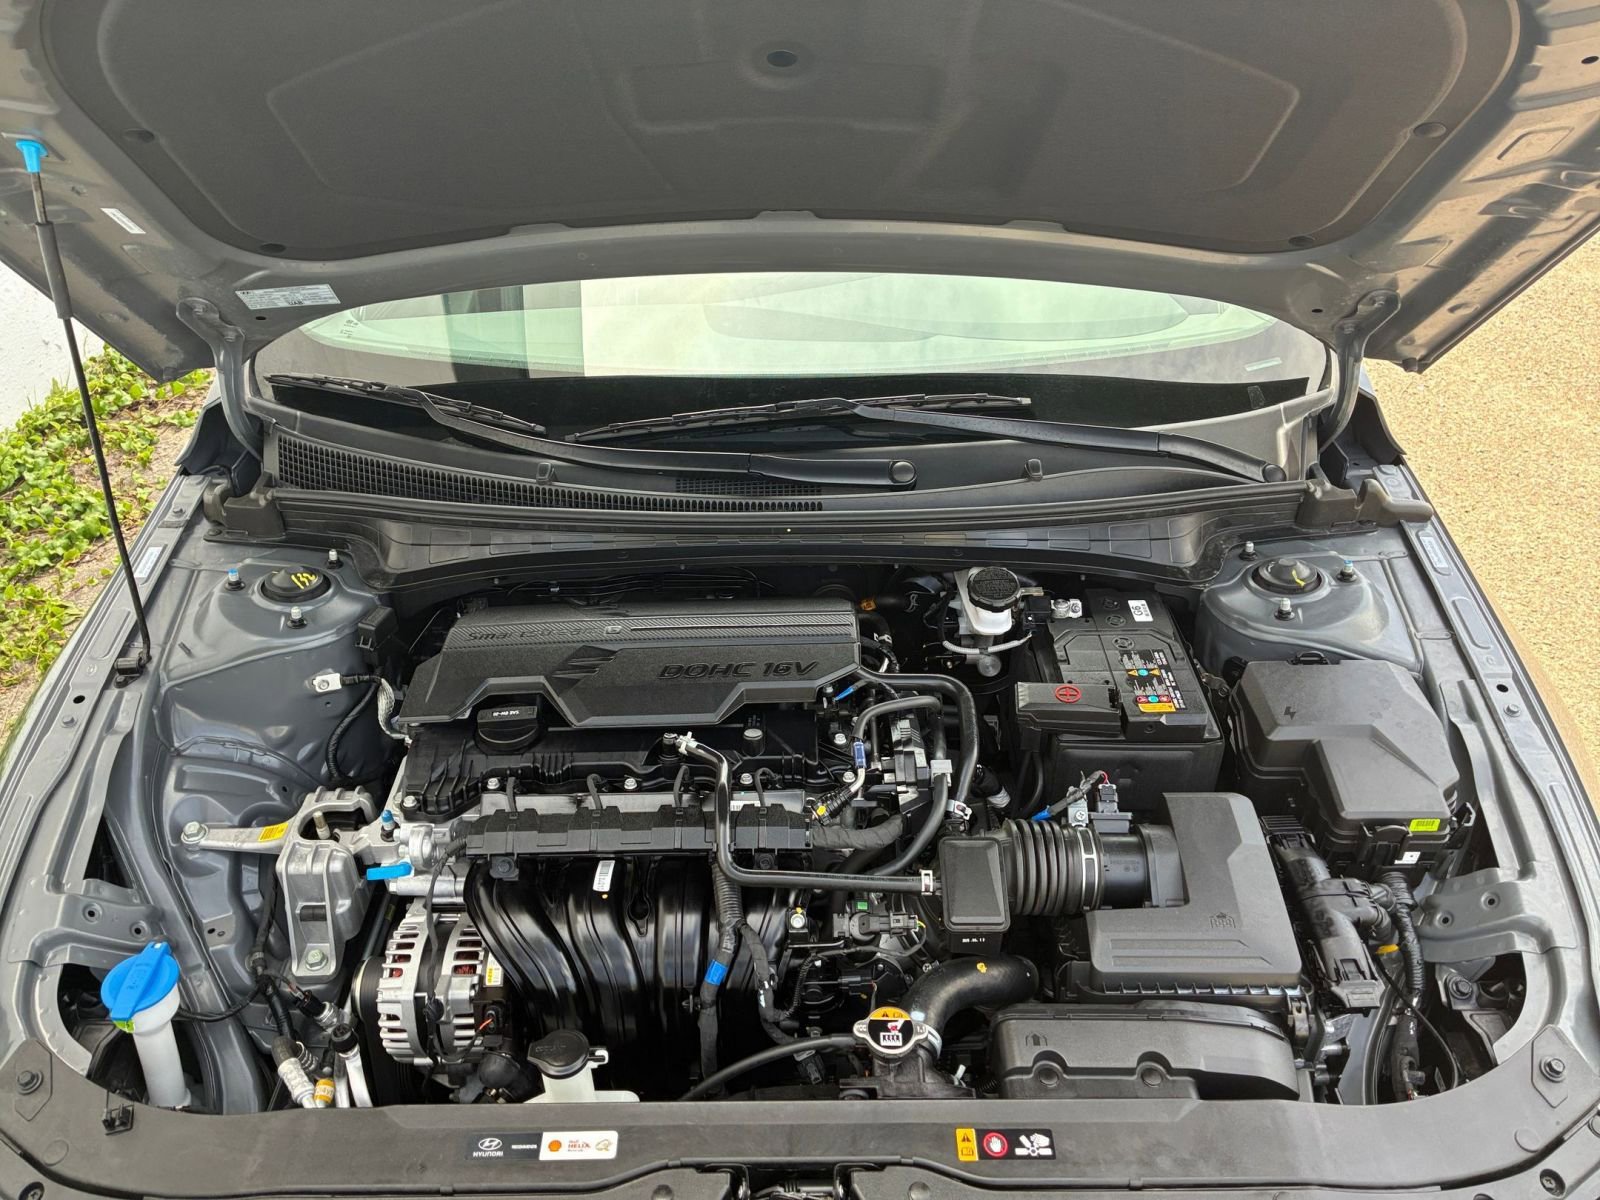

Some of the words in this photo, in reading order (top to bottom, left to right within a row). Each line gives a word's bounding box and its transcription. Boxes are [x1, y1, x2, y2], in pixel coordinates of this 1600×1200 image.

[1131, 605, 1144, 616] G6
[658, 662, 756, 678] DOHC
[763, 660, 819, 677] 16V
